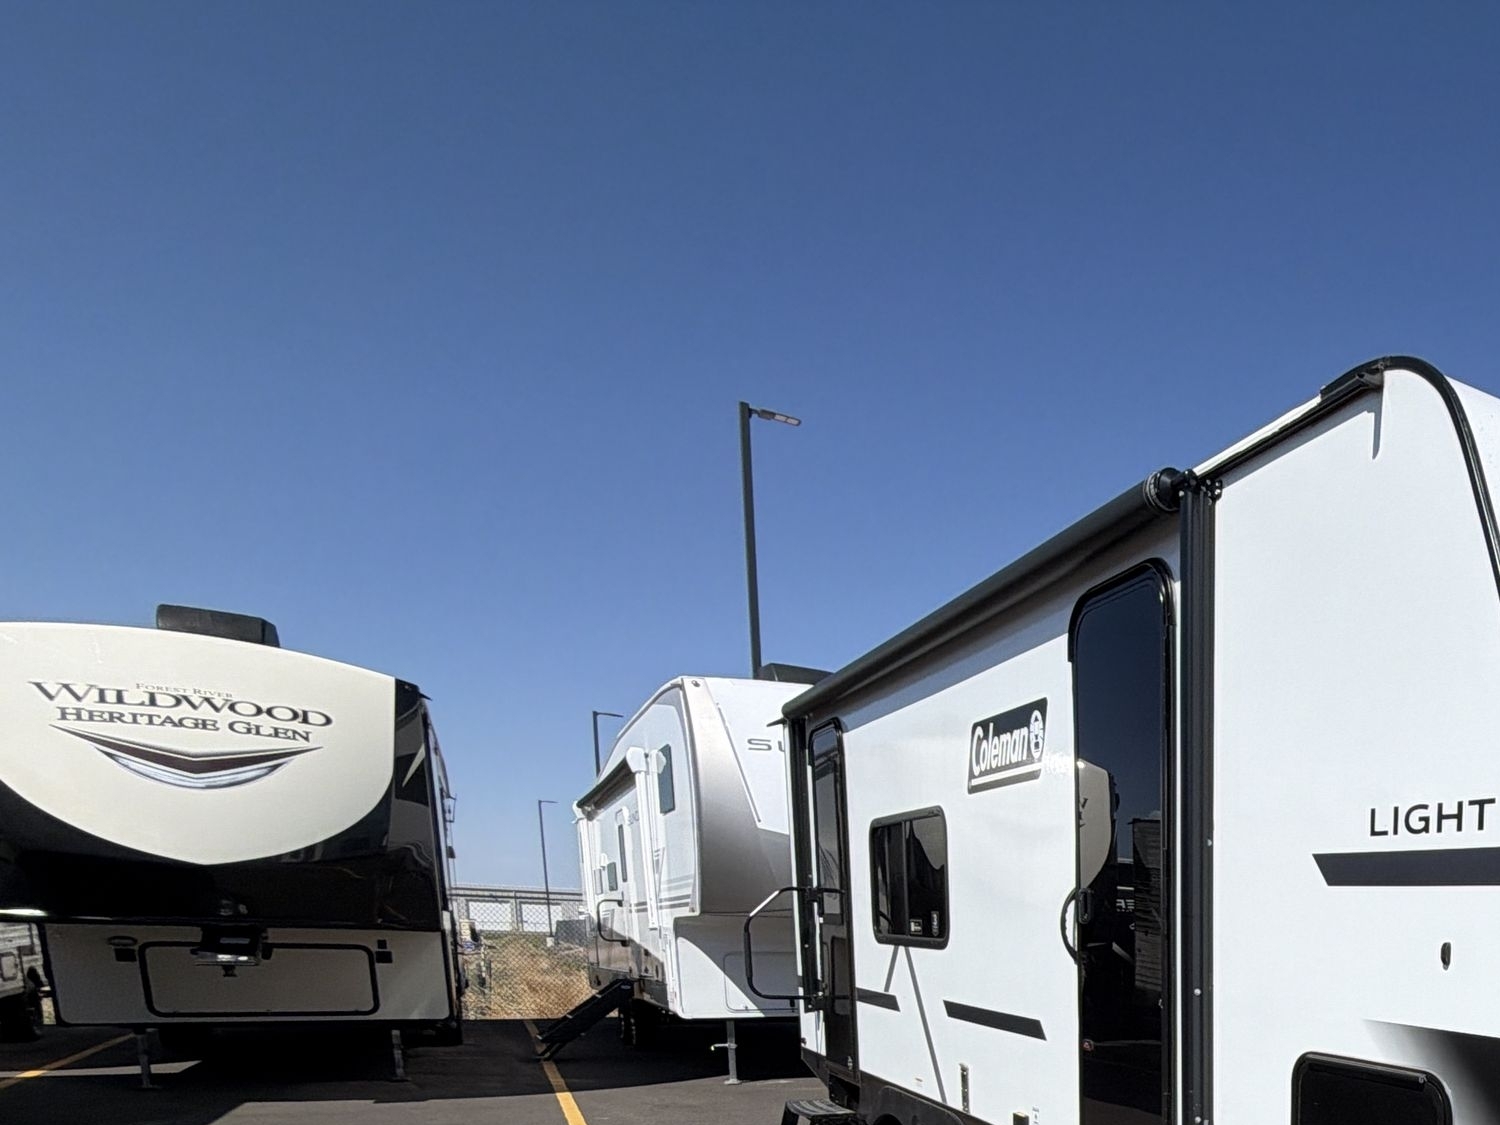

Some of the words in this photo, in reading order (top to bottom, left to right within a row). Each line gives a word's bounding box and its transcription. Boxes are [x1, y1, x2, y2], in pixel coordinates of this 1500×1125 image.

[27, 681, 333, 727] WILDWOOD
[56, 706, 220, 731] HERITAGE
[228, 720, 313, 743] GLEN
[971, 721, 1029, 777] Coleman
[1370, 797, 1496, 837] LIGHT
